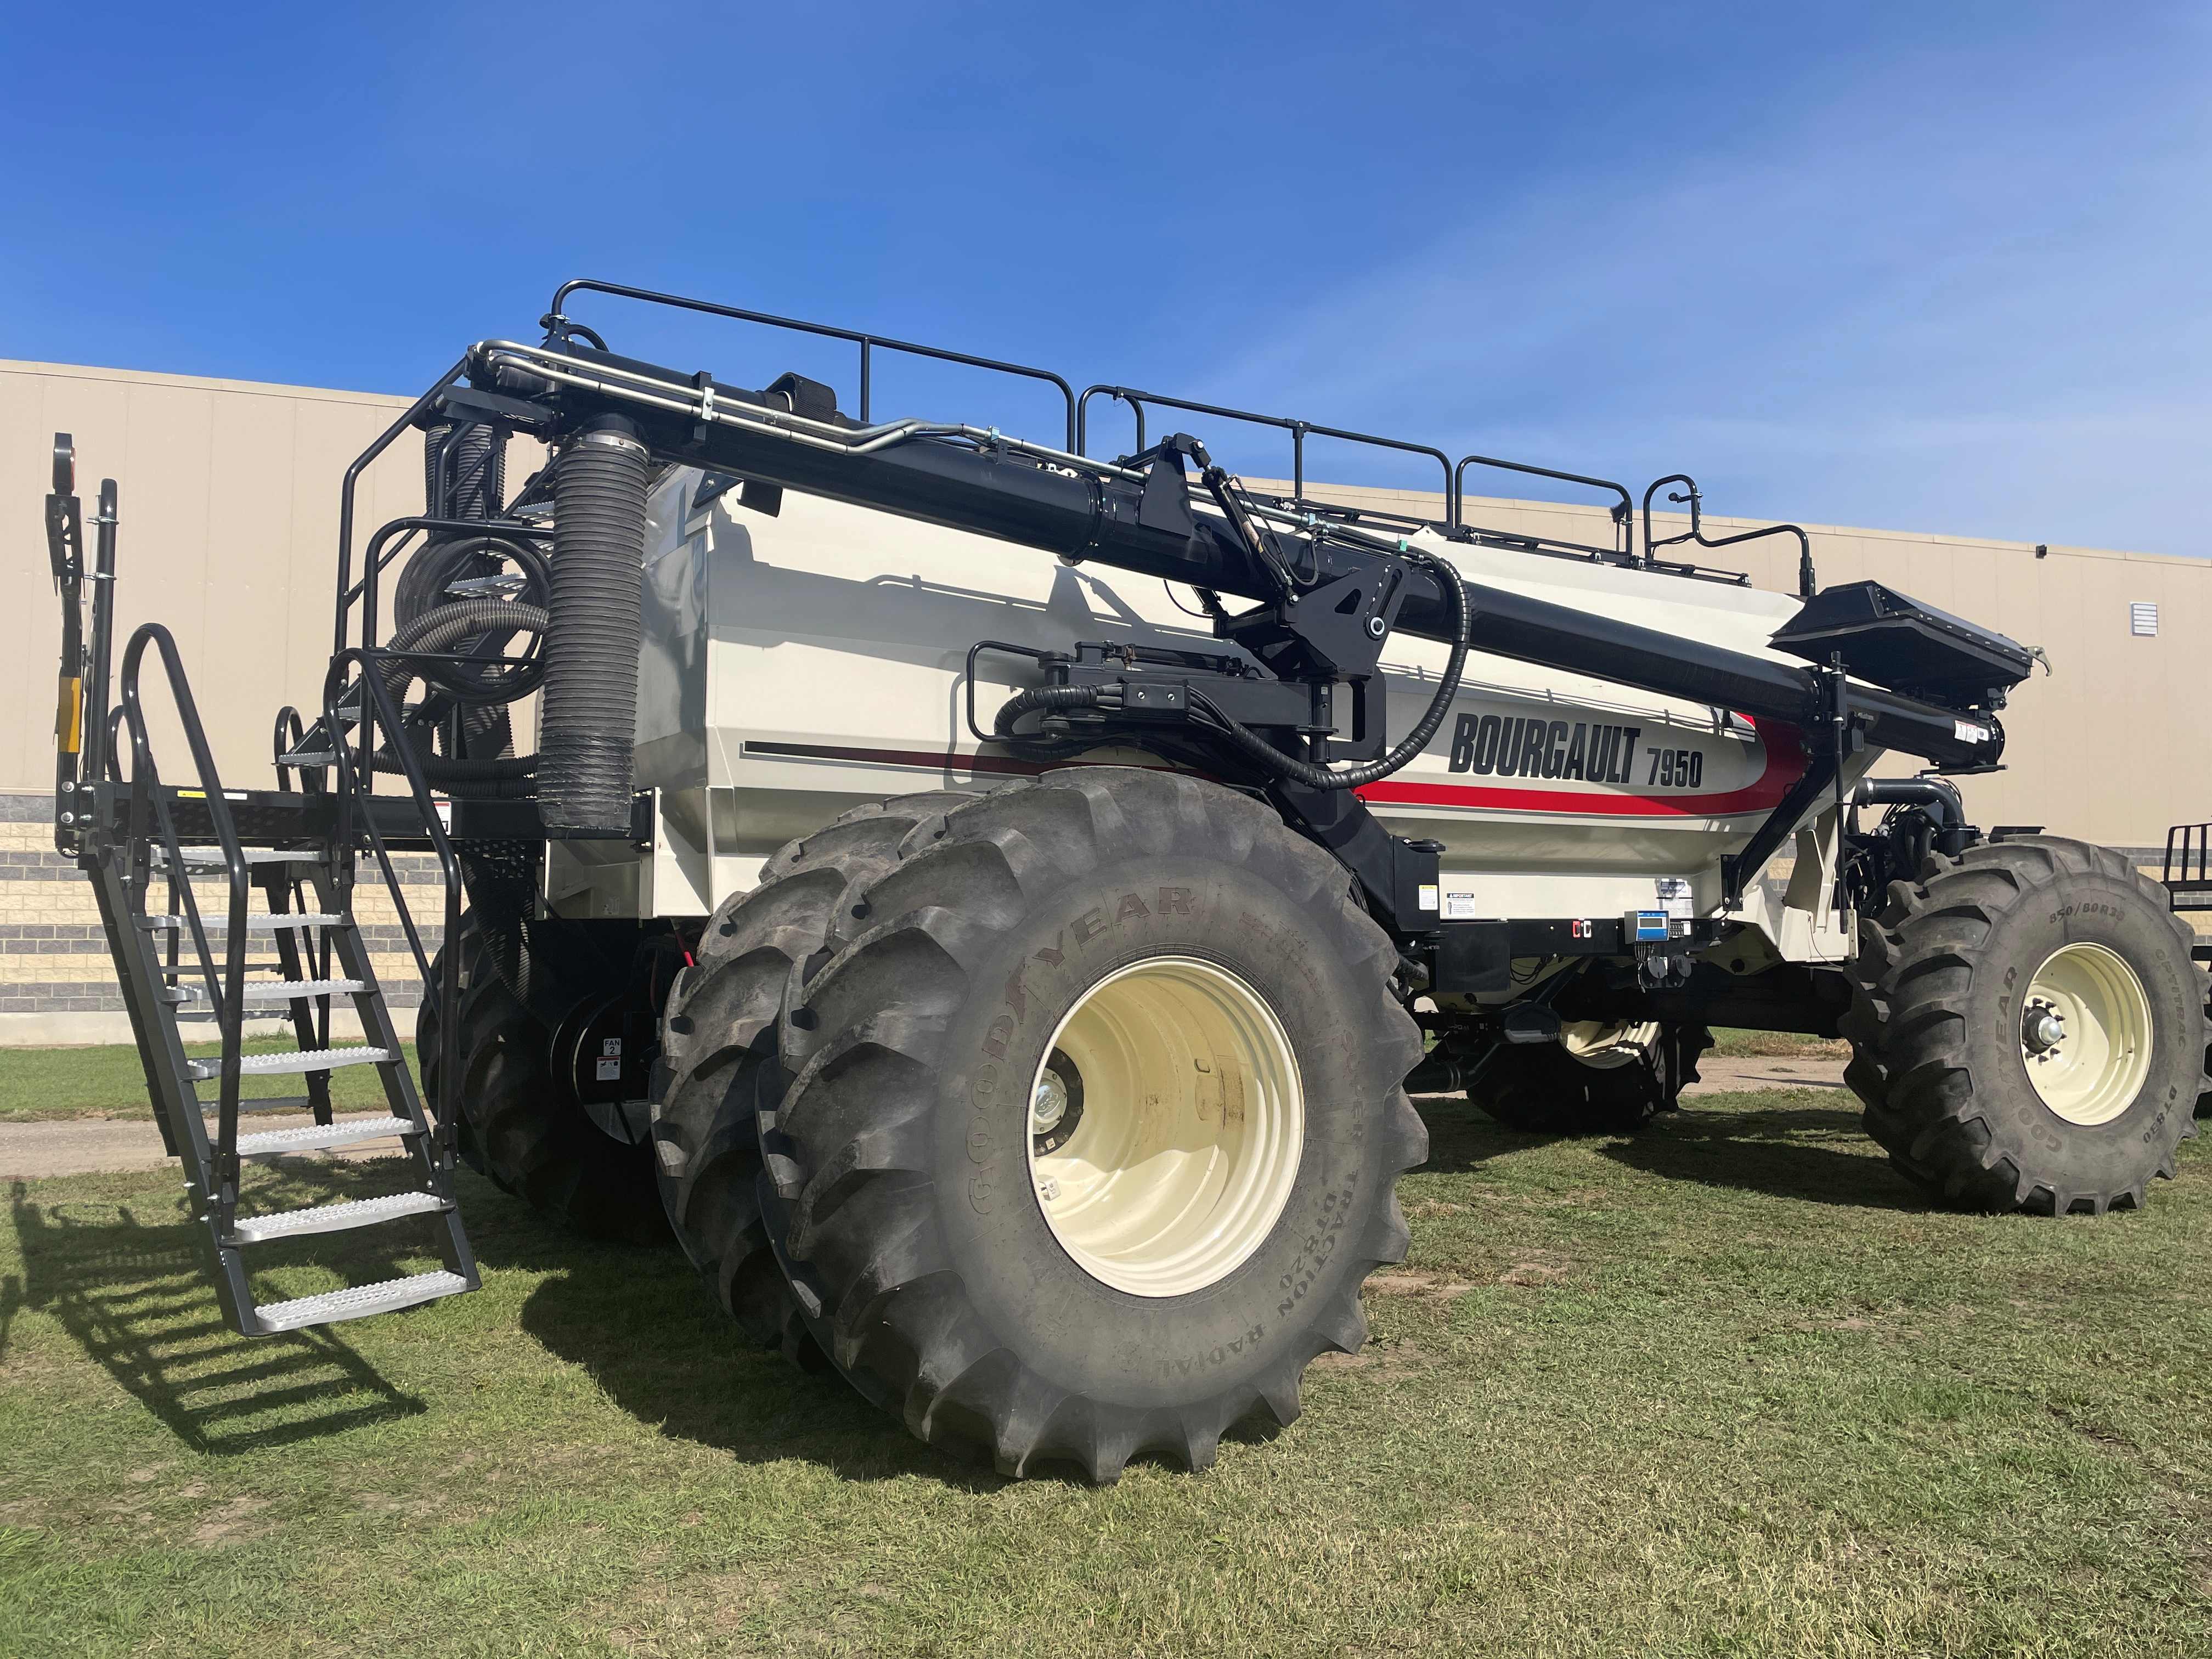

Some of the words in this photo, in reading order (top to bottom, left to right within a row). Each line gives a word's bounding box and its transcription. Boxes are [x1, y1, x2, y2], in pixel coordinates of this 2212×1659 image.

[1448, 713, 1641, 784] BOURGAULT
[1647, 748, 1703, 788] 7950
[2155, 949, 2186, 1049] OPTITRAC
[610, 1046, 615, 1054] 2
[1995, 966, 2062, 1153] GOODYEAR
[1277, 1170, 1359, 1317] TRACTION
[1279, 1192, 1338, 1290] DT820
[1155, 1323, 1265, 1379] RADIAL
